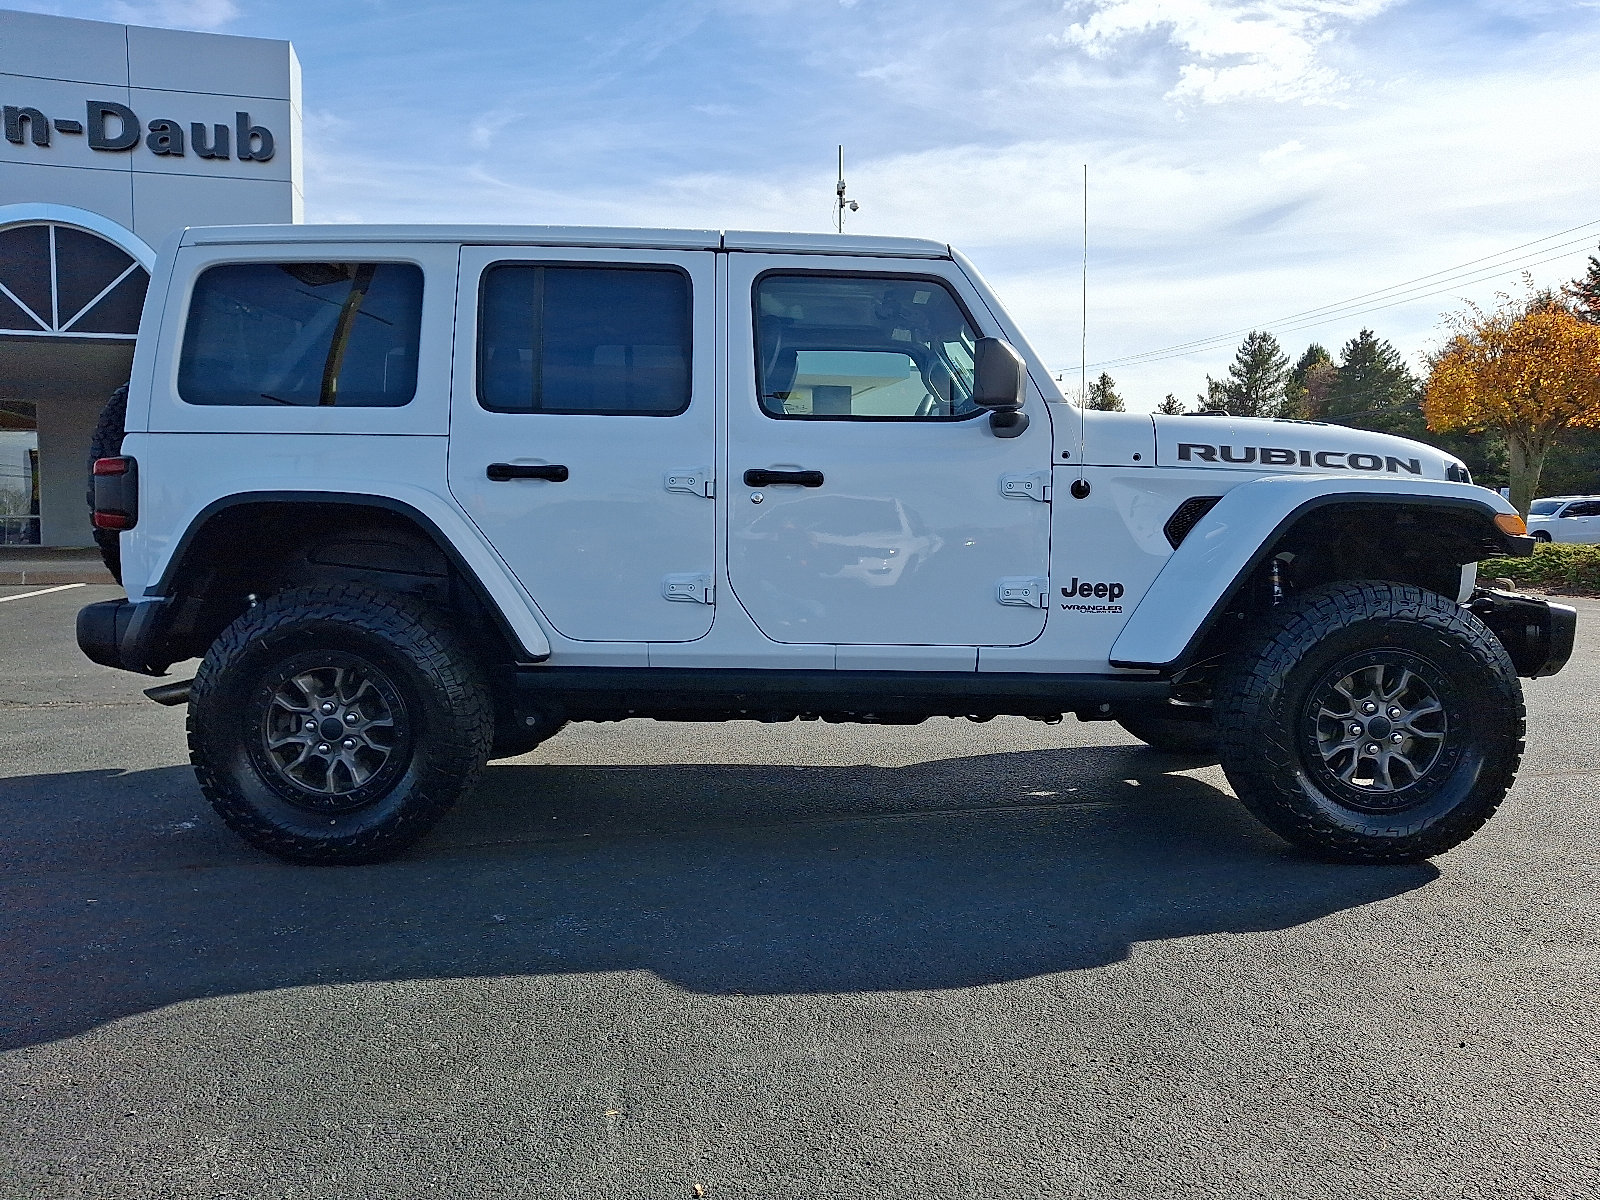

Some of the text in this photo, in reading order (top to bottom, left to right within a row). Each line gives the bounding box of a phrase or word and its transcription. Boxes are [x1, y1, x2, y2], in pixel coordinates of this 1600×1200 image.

[0, 100, 275, 162] n-Daub
[1177, 442, 1422, 475] RUBICON
[1061, 577, 1124, 602] Jeep
